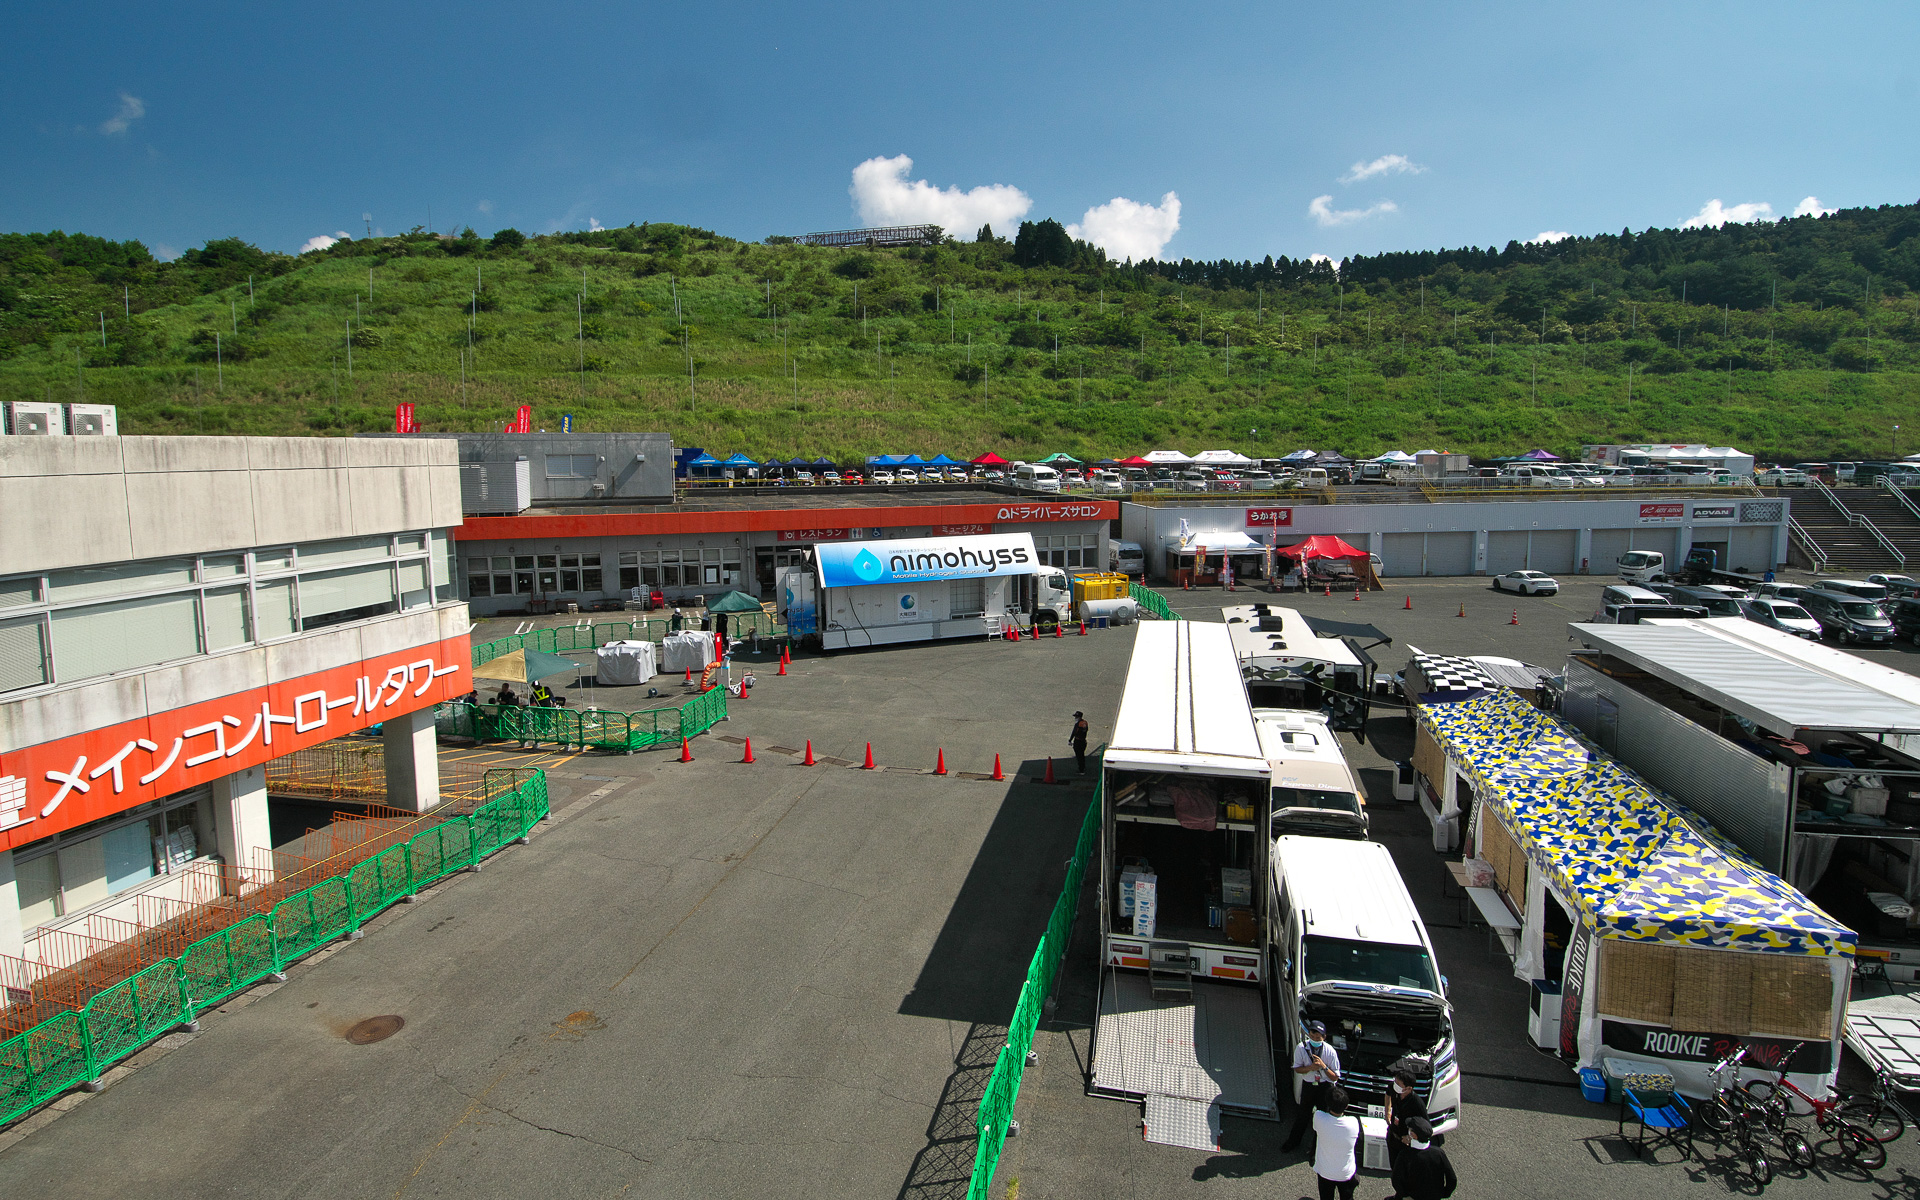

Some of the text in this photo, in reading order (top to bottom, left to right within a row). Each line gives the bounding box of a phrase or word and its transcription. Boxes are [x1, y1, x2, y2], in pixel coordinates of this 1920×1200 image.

[1010, 505, 1101, 519] ドライバーズサロン
[799, 529, 842, 537] レストラン
[941, 524, 984, 533] ミュージアム
[890, 546, 1029, 573] nimohyss
[919, 570, 958, 578] Hydrogen
[41, 658, 459, 817] メインコントロールタワー
[1282, 780, 1315, 789] Express
[1567, 933, 1587, 996] ROOKIE
[1643, 1031, 1711, 1057] ROOKIE
